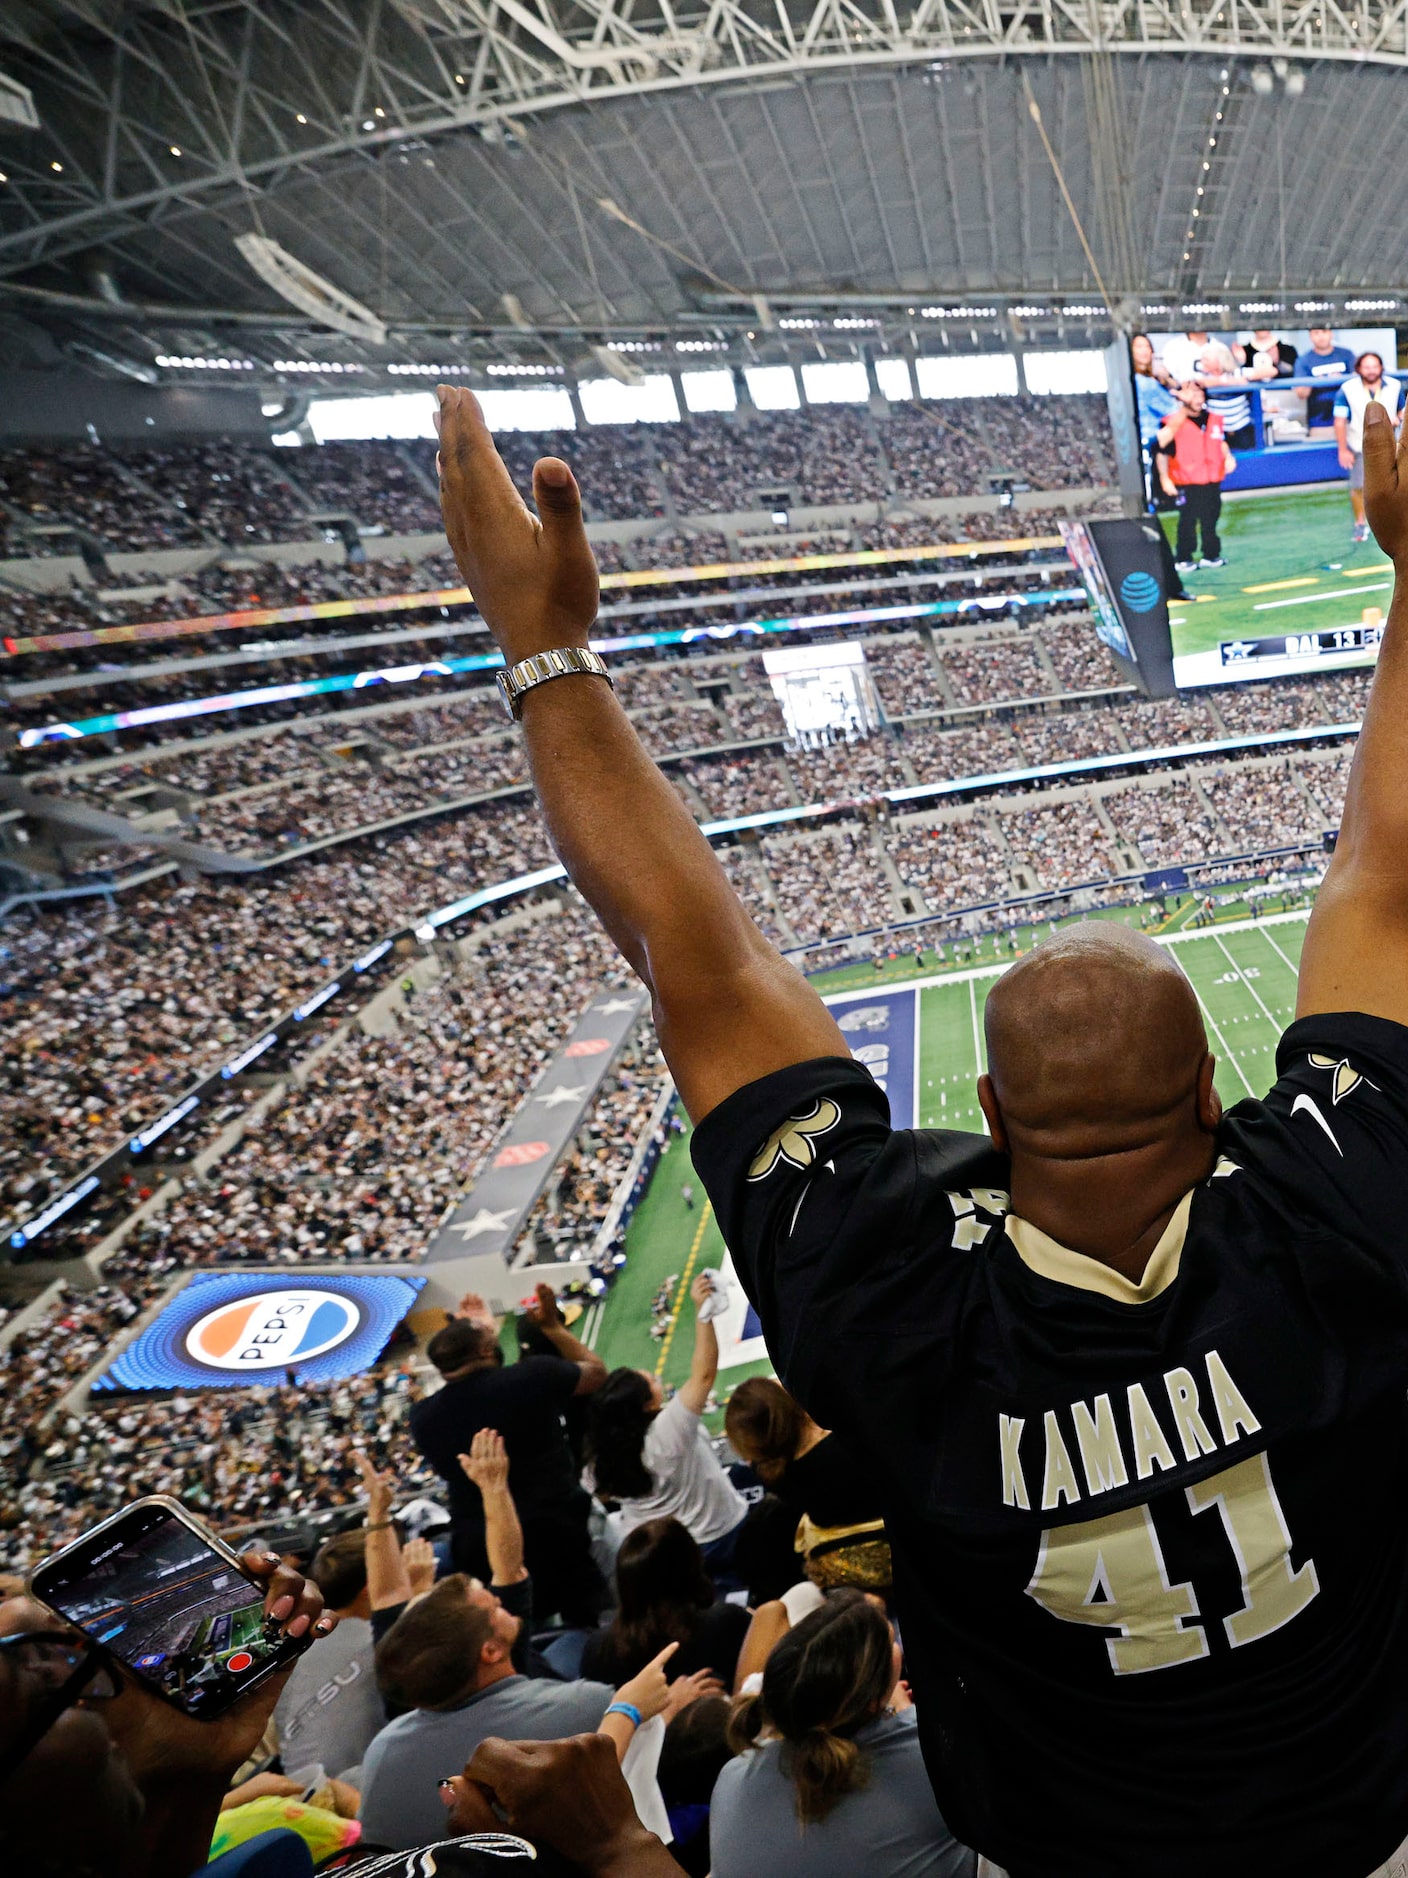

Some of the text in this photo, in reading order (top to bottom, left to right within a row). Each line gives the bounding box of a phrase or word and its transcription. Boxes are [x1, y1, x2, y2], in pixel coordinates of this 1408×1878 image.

[1285, 631, 1356, 655] DAL 13
[238, 1298, 310, 1360] PEPSI
[998, 1350, 1263, 1511] KAMARA
[1022, 1450, 1321, 1676] 41
